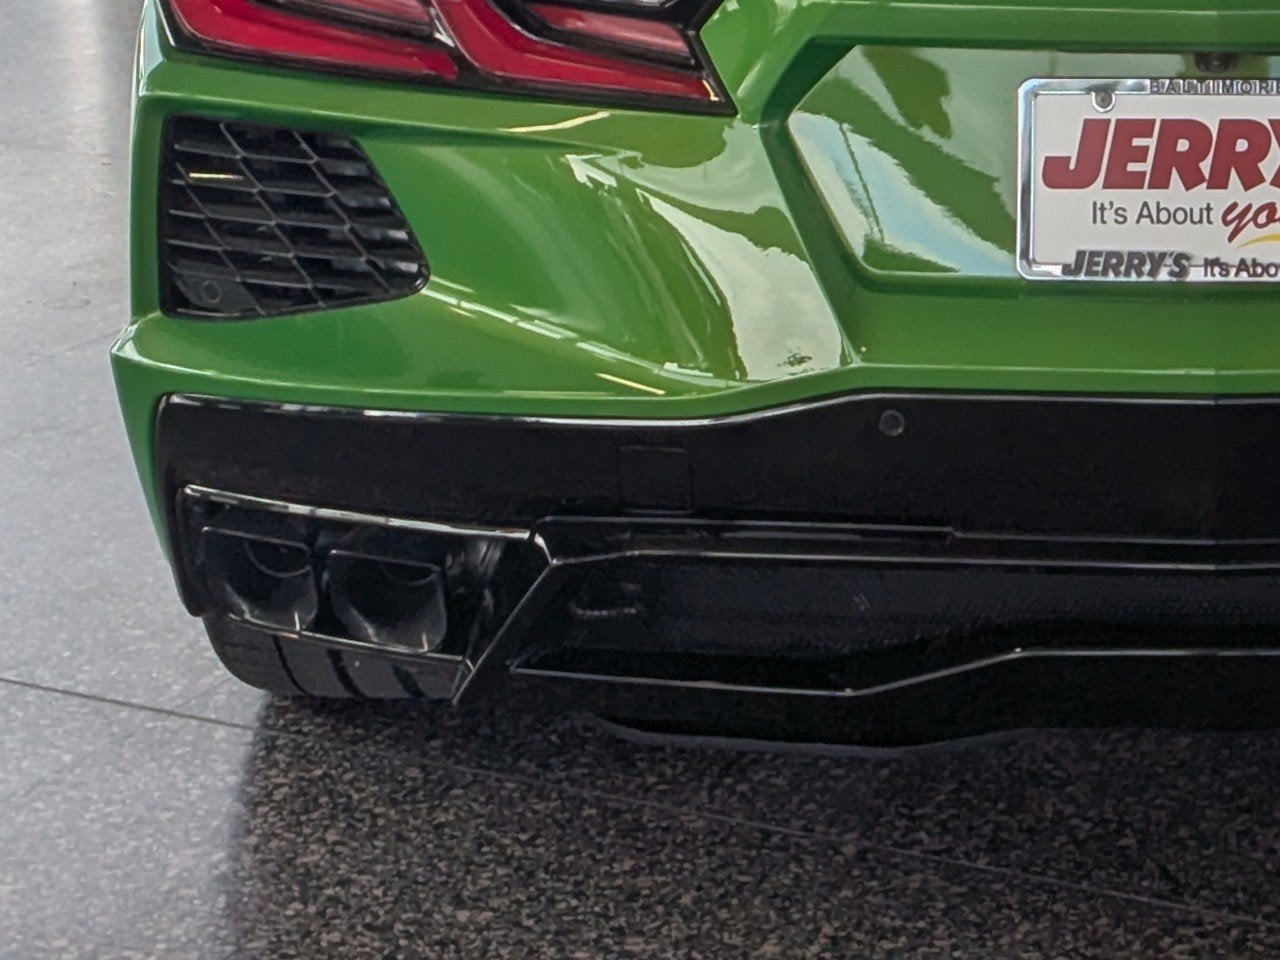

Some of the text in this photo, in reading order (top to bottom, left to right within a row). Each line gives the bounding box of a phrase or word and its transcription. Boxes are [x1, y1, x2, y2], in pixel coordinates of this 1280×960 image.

[1091, 201, 1128, 226] It's
[1135, 201, 1214, 225] About
[1061, 249, 1194, 279] JERRY'S
[1203, 256, 1232, 277] It's
